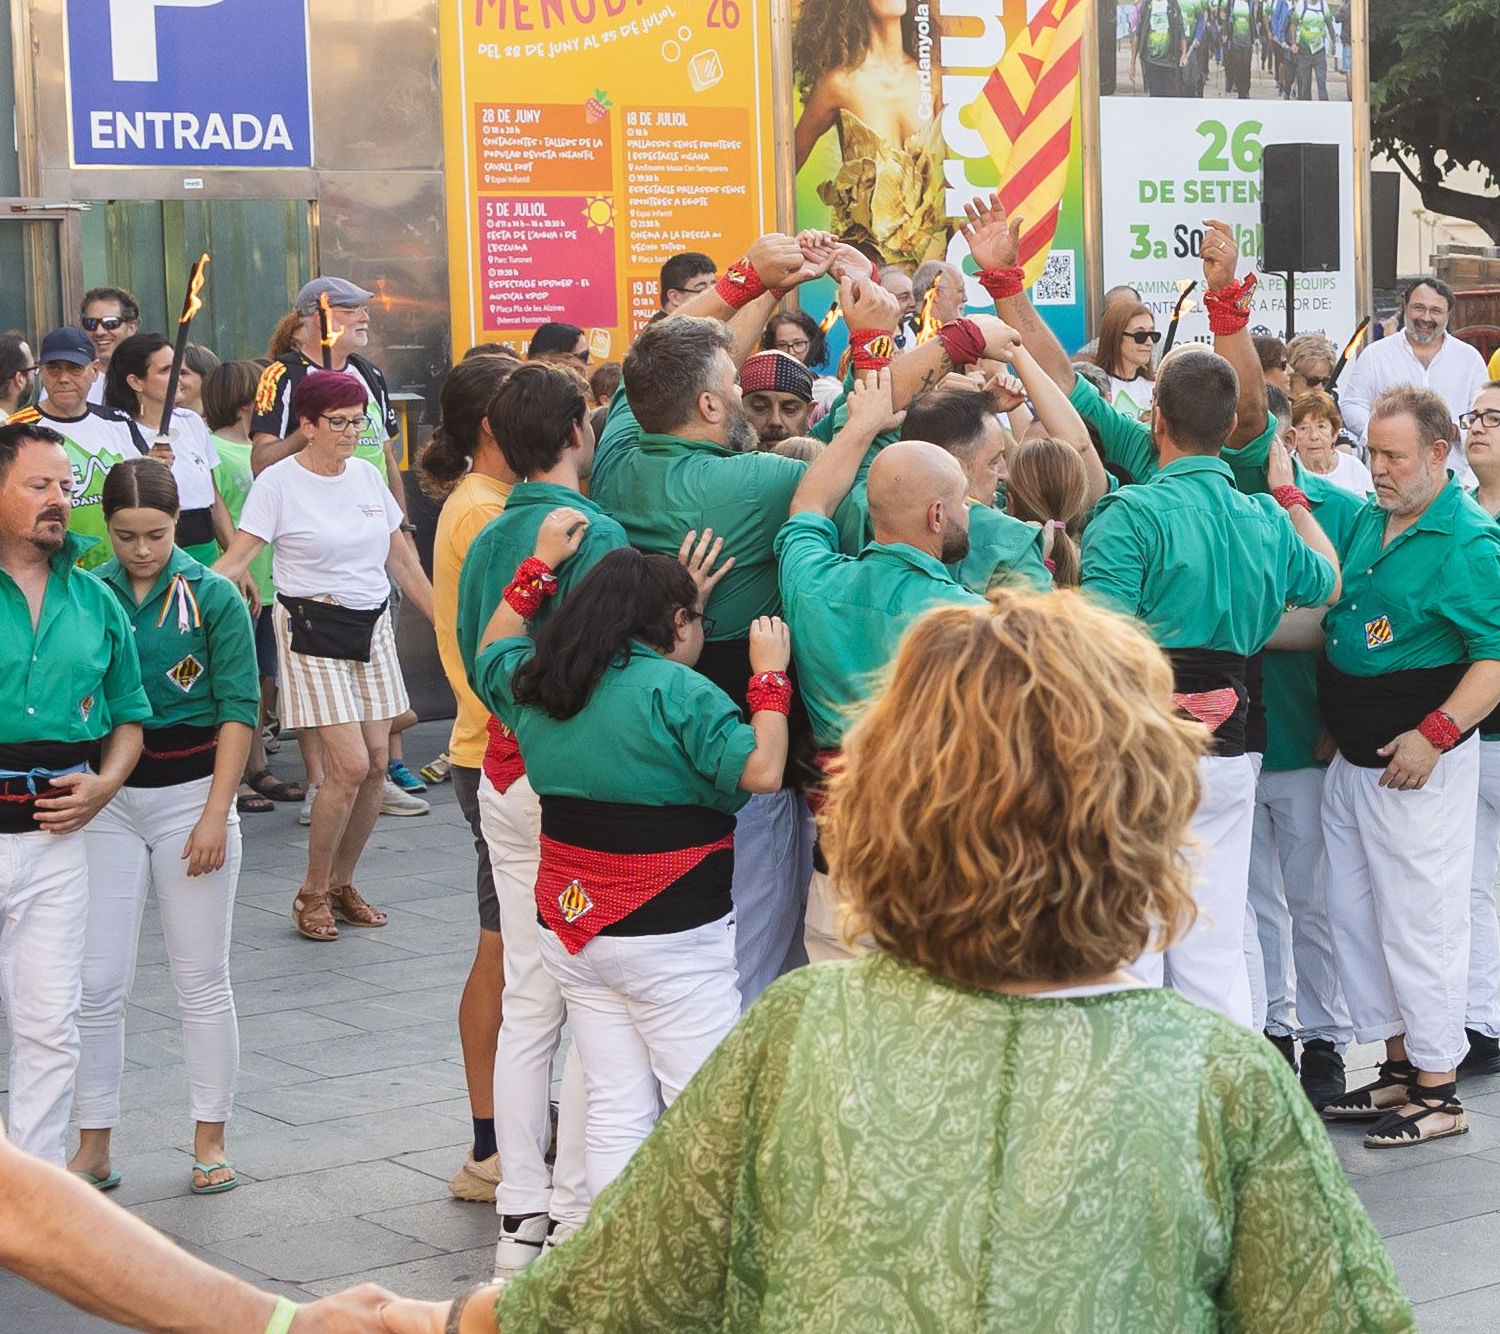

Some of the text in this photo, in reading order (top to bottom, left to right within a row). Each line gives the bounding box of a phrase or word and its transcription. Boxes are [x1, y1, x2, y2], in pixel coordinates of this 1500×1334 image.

[478, 43, 501, 59] DEL
[505, 46, 521, 57] 28
[525, 43, 544, 58] DE
[548, 40, 579, 58] JUNY
[583, 34, 600, 50] AL
[602, 30, 617, 43] 25
[620, 22, 640, 38] DE
[916, 3, 935, 120] Cerdanyola
[483, 109, 541, 123] 28 DE JUNY
[627, 112, 688, 126] 18 DE JULIOL
[91, 110, 294, 153] ENTRADA
[1196, 120, 1264, 173] 26
[1139, 180, 1175, 203] DE
[486, 203, 547, 217] 5 DE JULIOL
[1130, 224, 1168, 260] 3a
[633, 281, 658, 295] 19 DE
[1294, 277, 1336, 291] EQUIPS
[1272, 298, 1315, 312] FAOR
